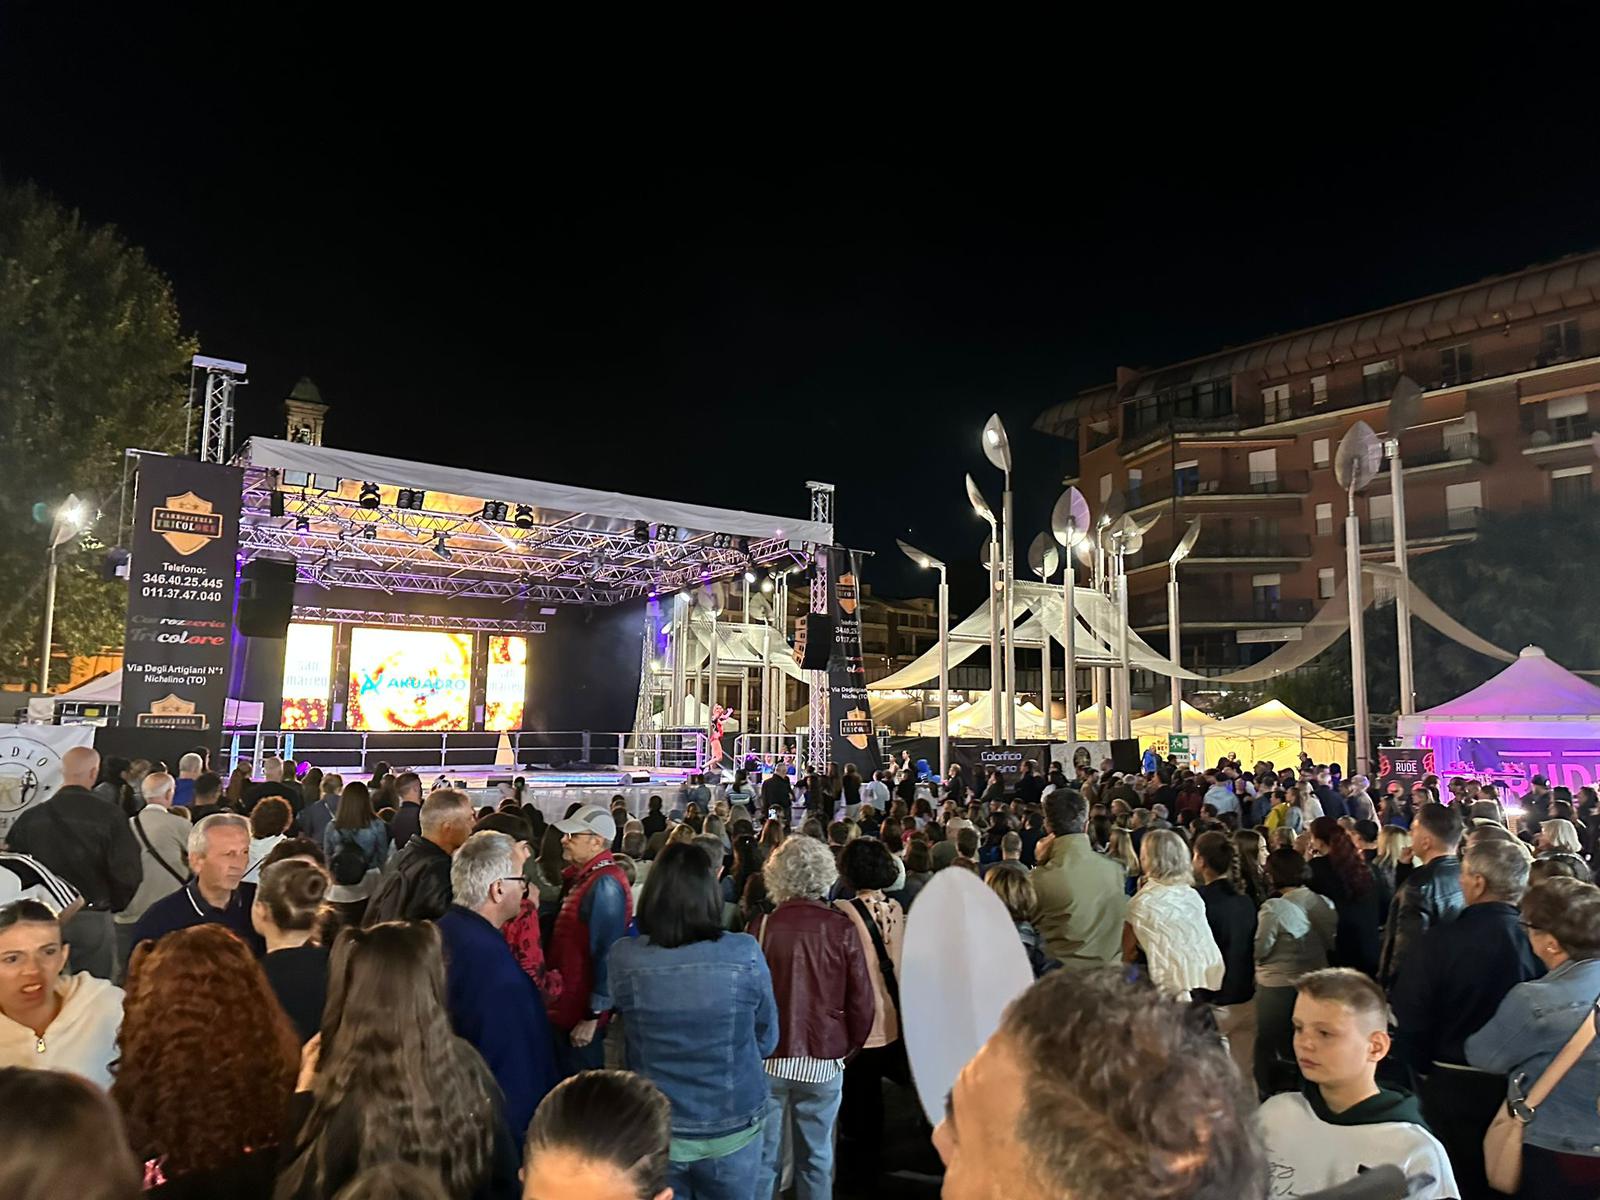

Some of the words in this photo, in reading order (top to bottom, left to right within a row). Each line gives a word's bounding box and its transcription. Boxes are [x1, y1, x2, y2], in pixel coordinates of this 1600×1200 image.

[156, 519, 217, 533] TRICOLORE
[162, 562, 207, 575] Telefono:
[142, 573, 224, 589] 346.40.25.445
[142, 586, 222, 602] 011.37.47.040
[131, 628, 225, 645] Tricolore
[126, 663, 143, 672] Via
[144, 664, 167, 674] Degli
[168, 665, 206, 675] Artigiani
[144, 674, 185, 684] Nichelino
[186, 676, 207, 686] (TO)
[1395, 761, 1418, 773] RUDE
